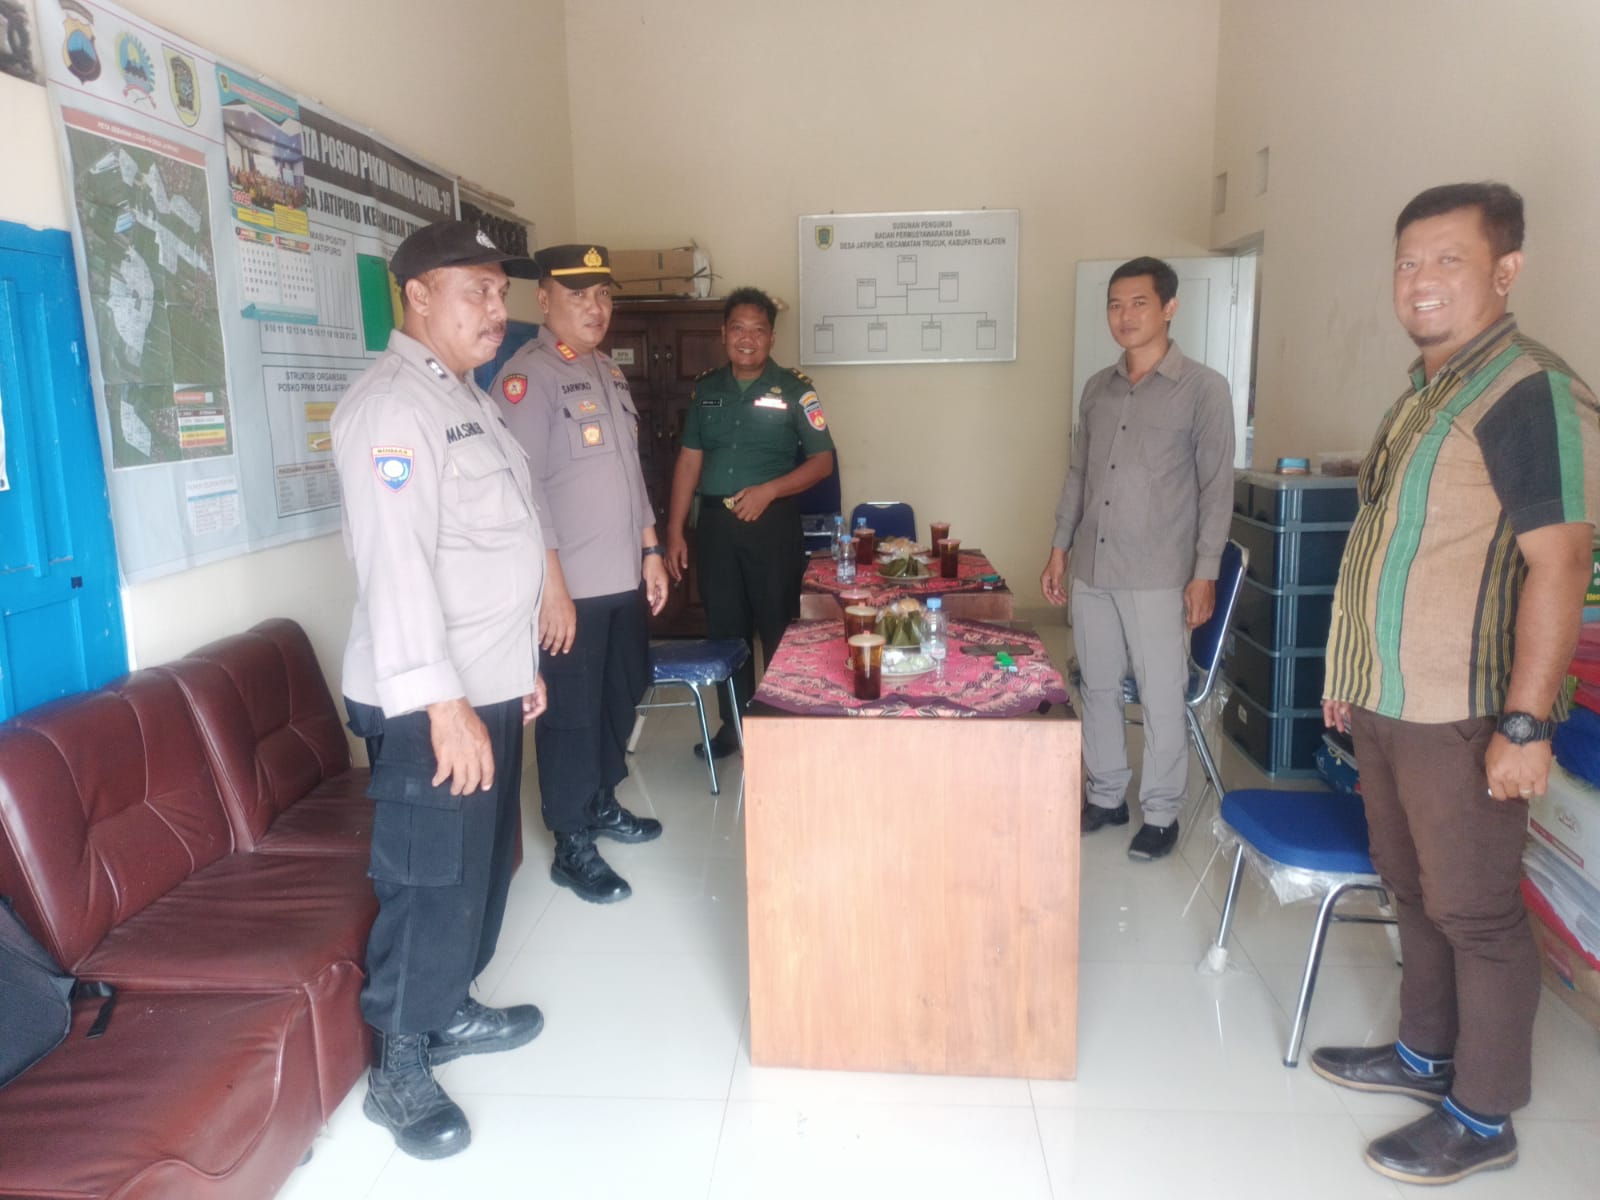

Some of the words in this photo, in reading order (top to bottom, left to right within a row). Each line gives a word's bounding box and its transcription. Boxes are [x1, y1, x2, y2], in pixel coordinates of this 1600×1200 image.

[300, 125, 320, 162] TA
[320, 132, 358, 176] POSKO
[415, 177, 451, 217] COVID-19
[319, 187, 361, 223] JATIPURO
[921, 221, 952, 229] PENGURUS
[874, 231, 895, 239] BADAN
[954, 228, 971, 237] DESA
[840, 241, 855, 250] DESA
[886, 240, 921, 248] KECAMATAN
[948, 238, 982, 247] KABUPATEN
[983, 237, 1007, 246] KLATEN
[286, 370, 315, 381] STRUKTUR
[278, 383, 300, 392] POSKO
[300, 383, 316, 392] PPKM
[316, 383, 332, 392] DESA
